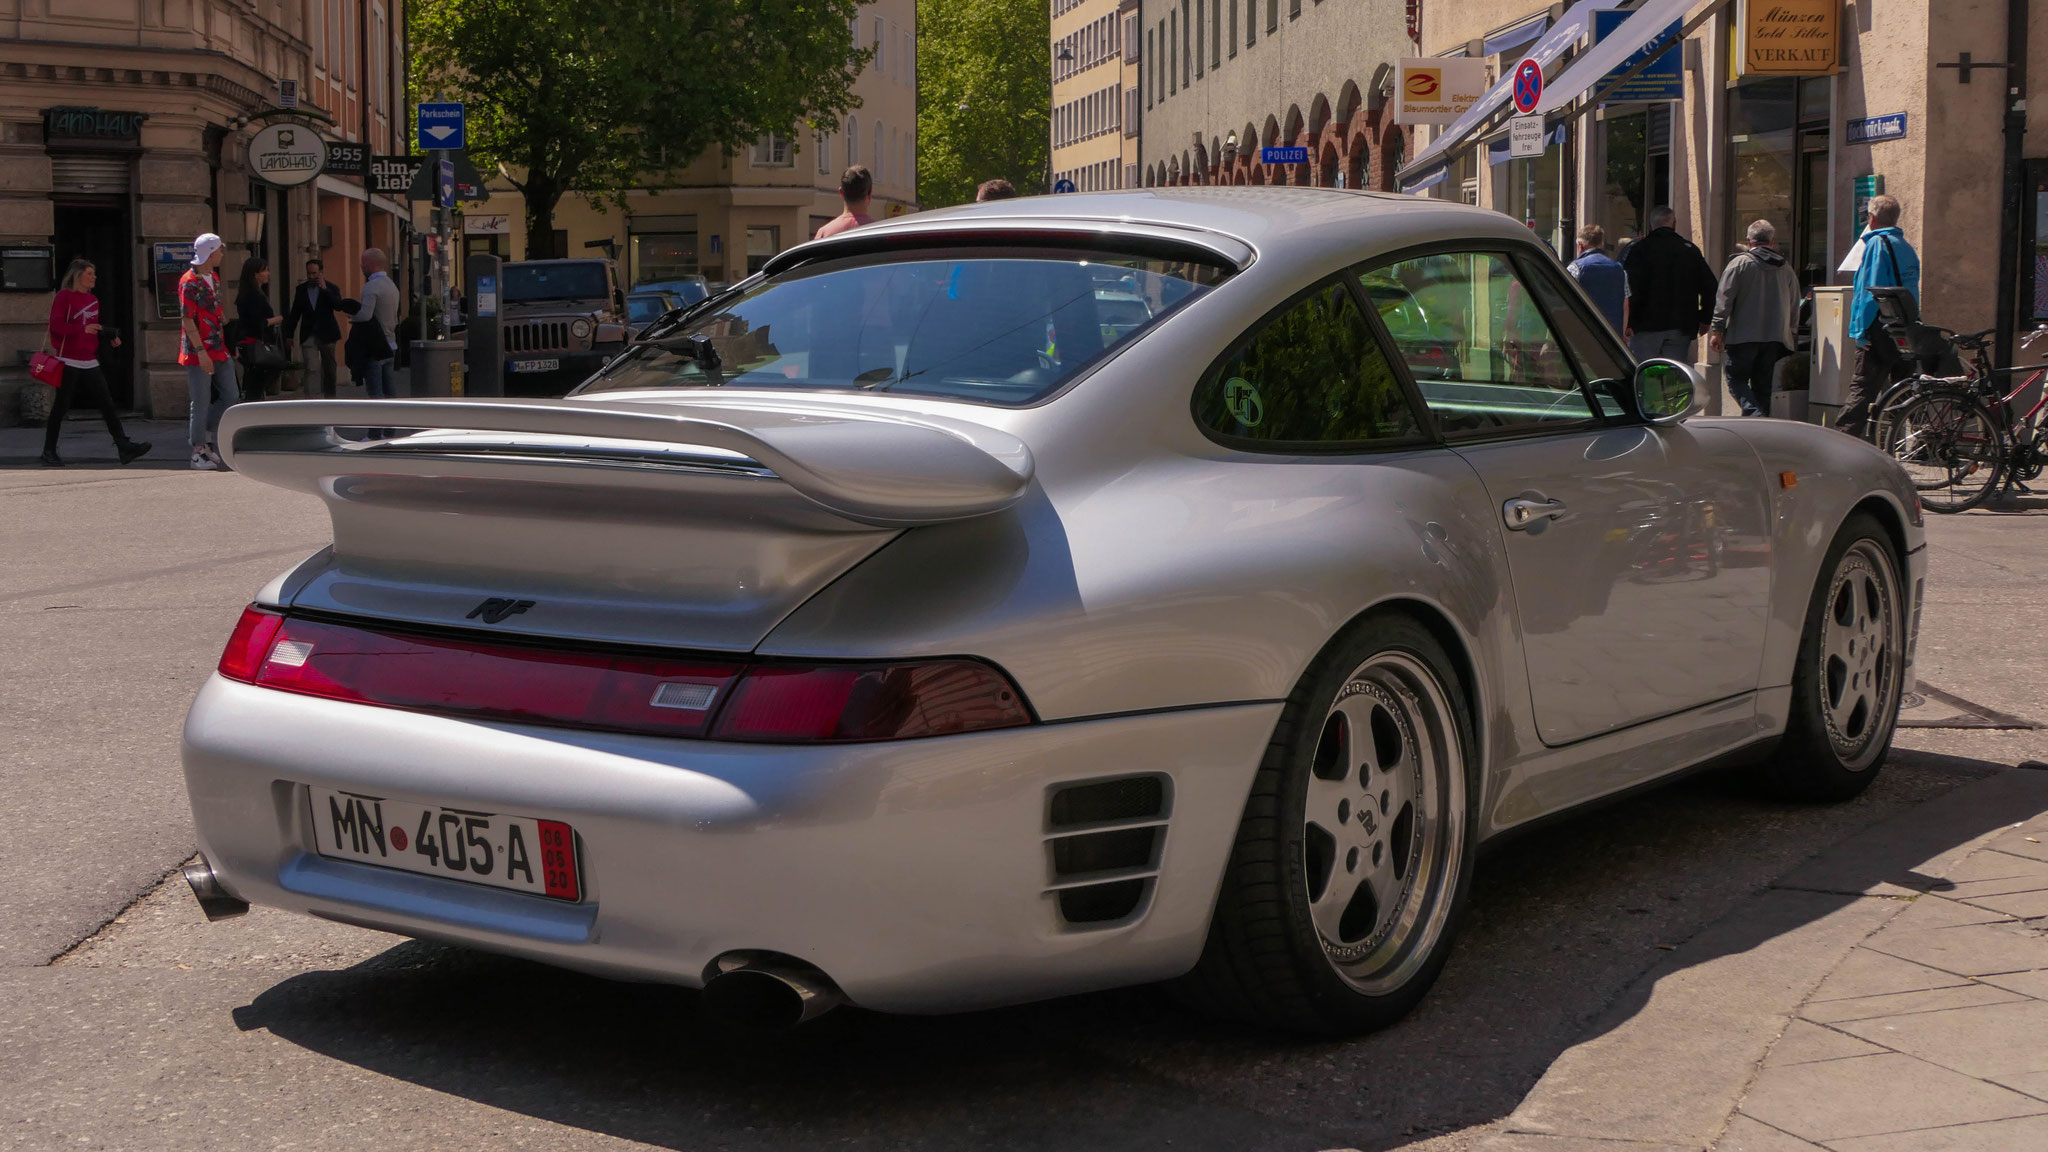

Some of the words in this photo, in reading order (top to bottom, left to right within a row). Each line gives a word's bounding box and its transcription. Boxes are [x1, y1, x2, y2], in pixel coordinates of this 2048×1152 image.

[1759, 6, 1825, 23] Münzen
[1754, 26, 1787, 39] Gold
[1790, 27, 1829, 39] Silber
[1754, 48, 1831, 62] VERKAUF
[421, 108, 461, 119] Parkschein
[50, 111, 143, 135] LANDHAUS
[1515, 121, 1539, 130] Einsatz-
[1513, 132, 1541, 142] fahrzeuge
[1522, 143, 1533, 151] frei
[260, 155, 317, 170] LANDHAUS
[1267, 150, 1303, 161] POLIZEI
[326, 161, 361, 170] terior
[372, 160, 408, 175] alm
[377, 175, 413, 190] lieb
[538, 360, 558, 369] 1328
[329, 796, 387, 857] MN
[416, 810, 494, 875] 405
[508, 824, 534, 884] A
[546, 849, 566, 868] 05
[549, 870, 568, 889] 20
